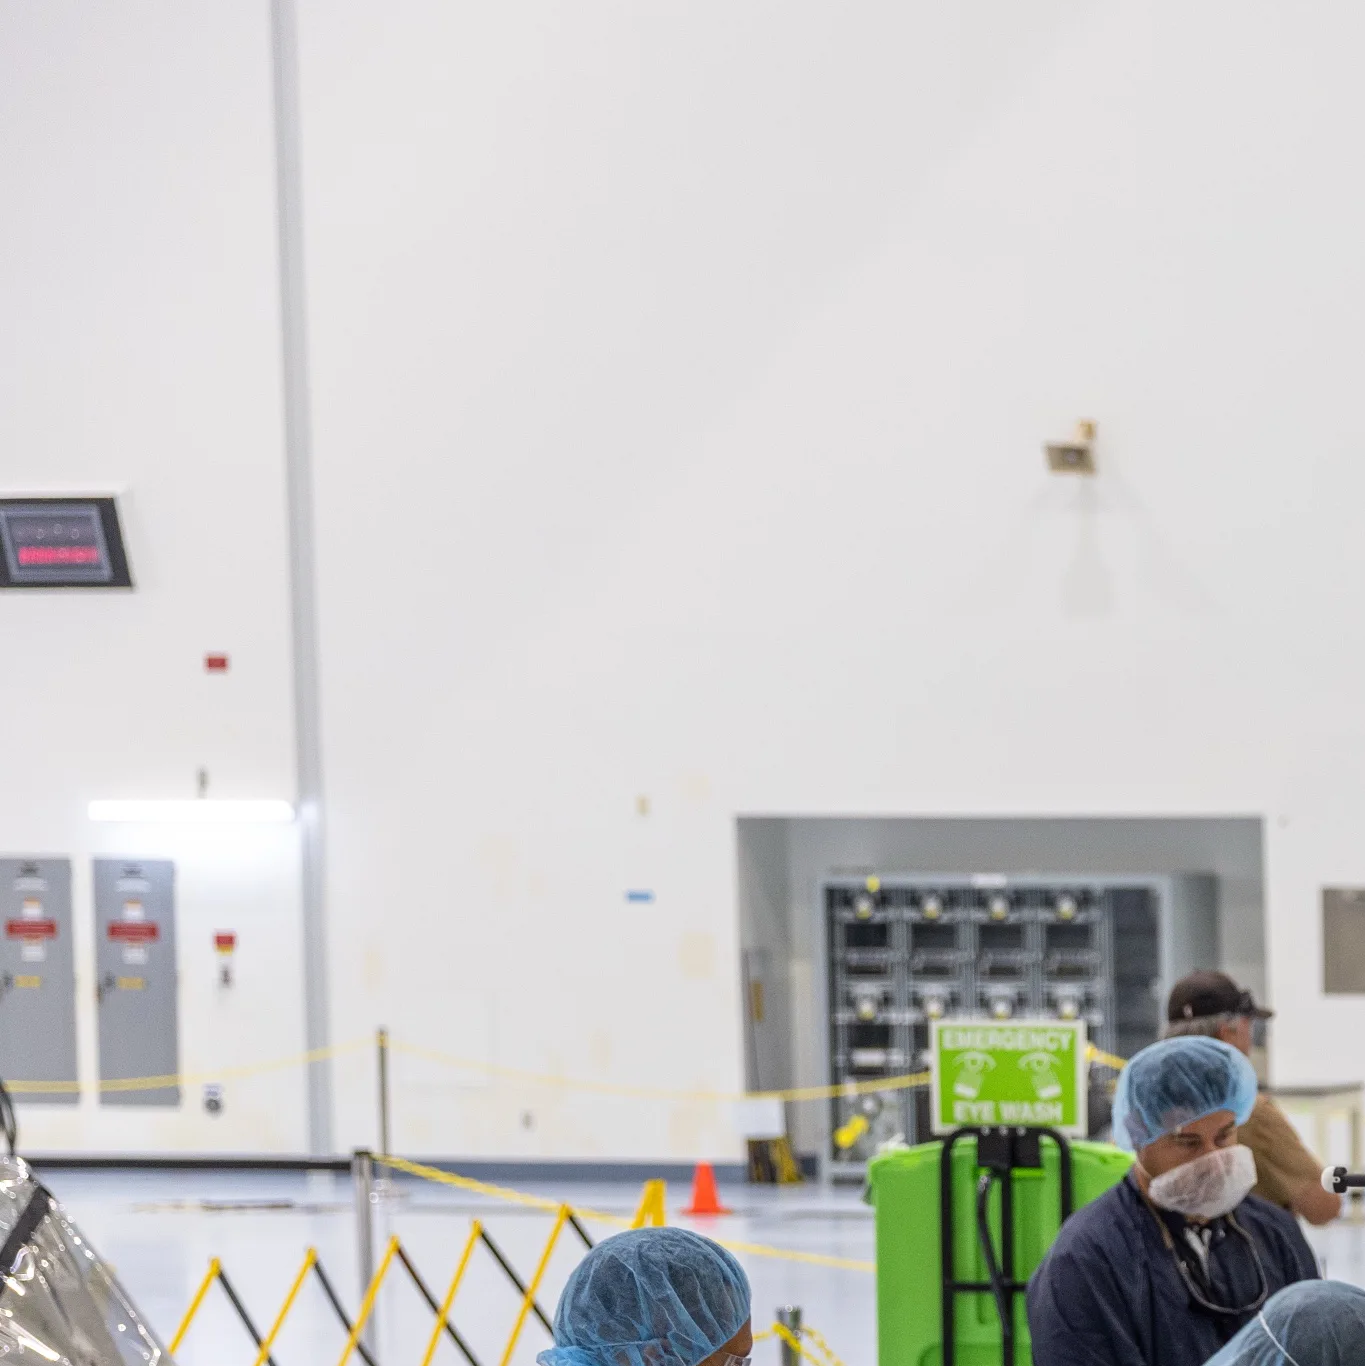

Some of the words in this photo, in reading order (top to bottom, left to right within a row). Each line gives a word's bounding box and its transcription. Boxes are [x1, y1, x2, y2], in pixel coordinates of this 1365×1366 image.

[942, 1029, 1072, 1051] EMERGENCY
[953, 1101, 995, 1122] EYE
[999, 1101, 1063, 1122] WASH
